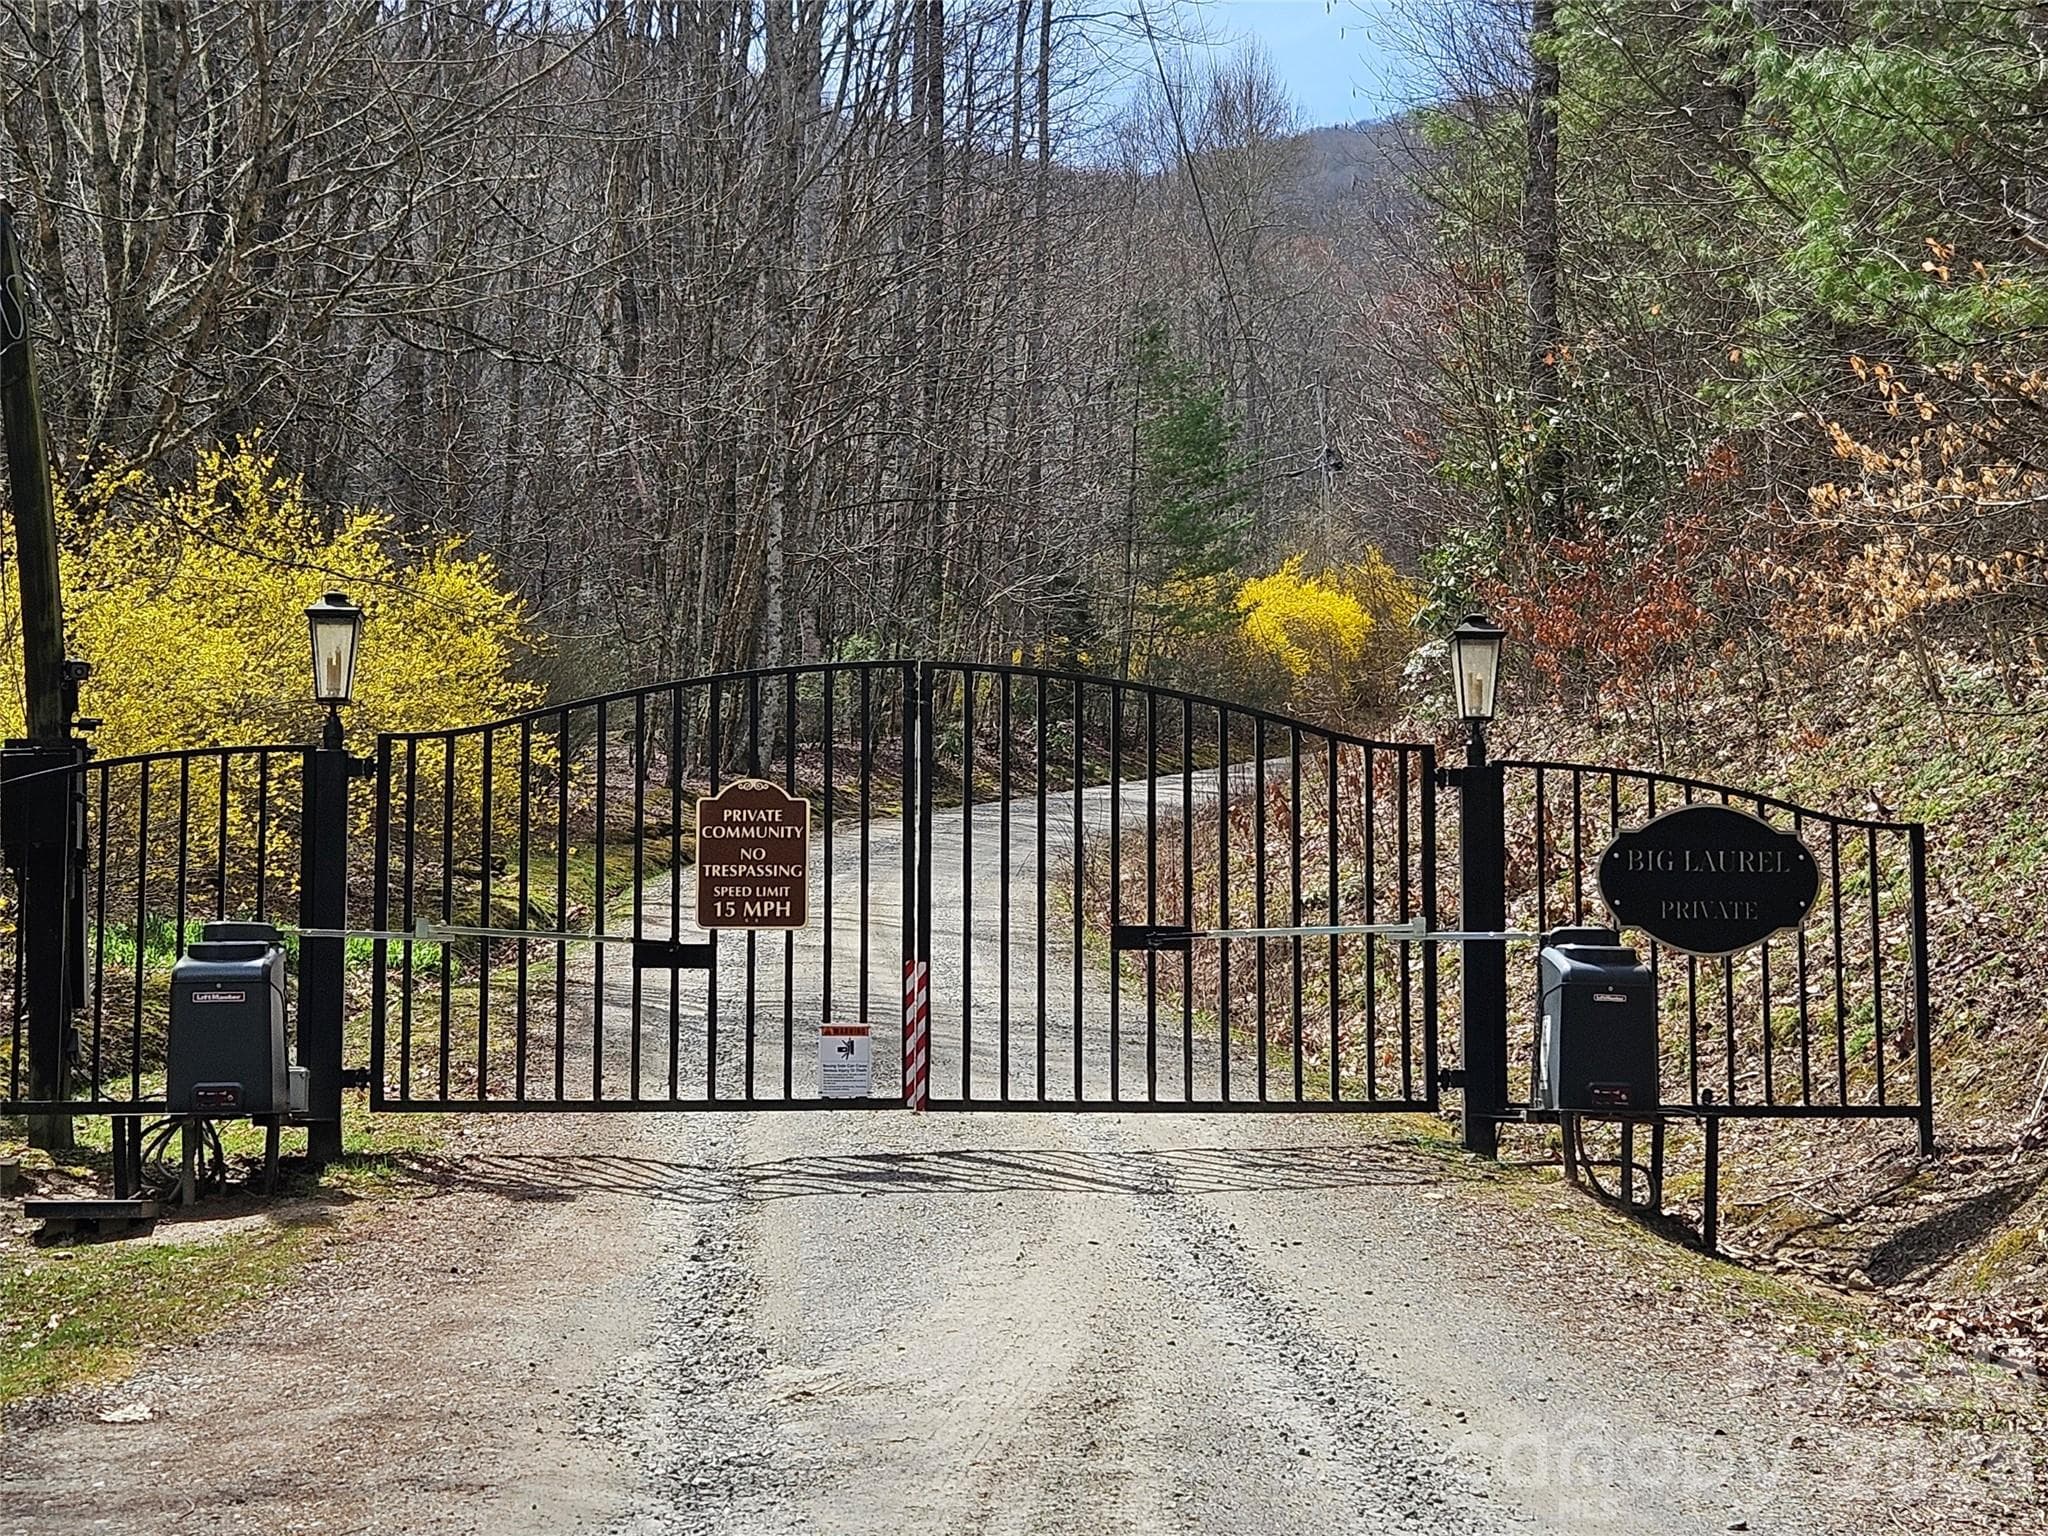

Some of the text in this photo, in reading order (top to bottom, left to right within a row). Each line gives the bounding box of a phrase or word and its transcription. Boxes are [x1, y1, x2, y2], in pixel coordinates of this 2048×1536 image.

[723, 809, 783, 822] PRIVATE
[702, 826, 804, 839] COMMUNITY
[740, 848, 766, 861] NO
[1628, 849, 1791, 873] BIG LAUREL
[703, 864, 802, 877] TRESPASSING
[713, 886, 791, 897] SPEED LIMIT
[713, 901, 791, 917] 15 MPH
[1661, 901, 1758, 920] PRIVATE
